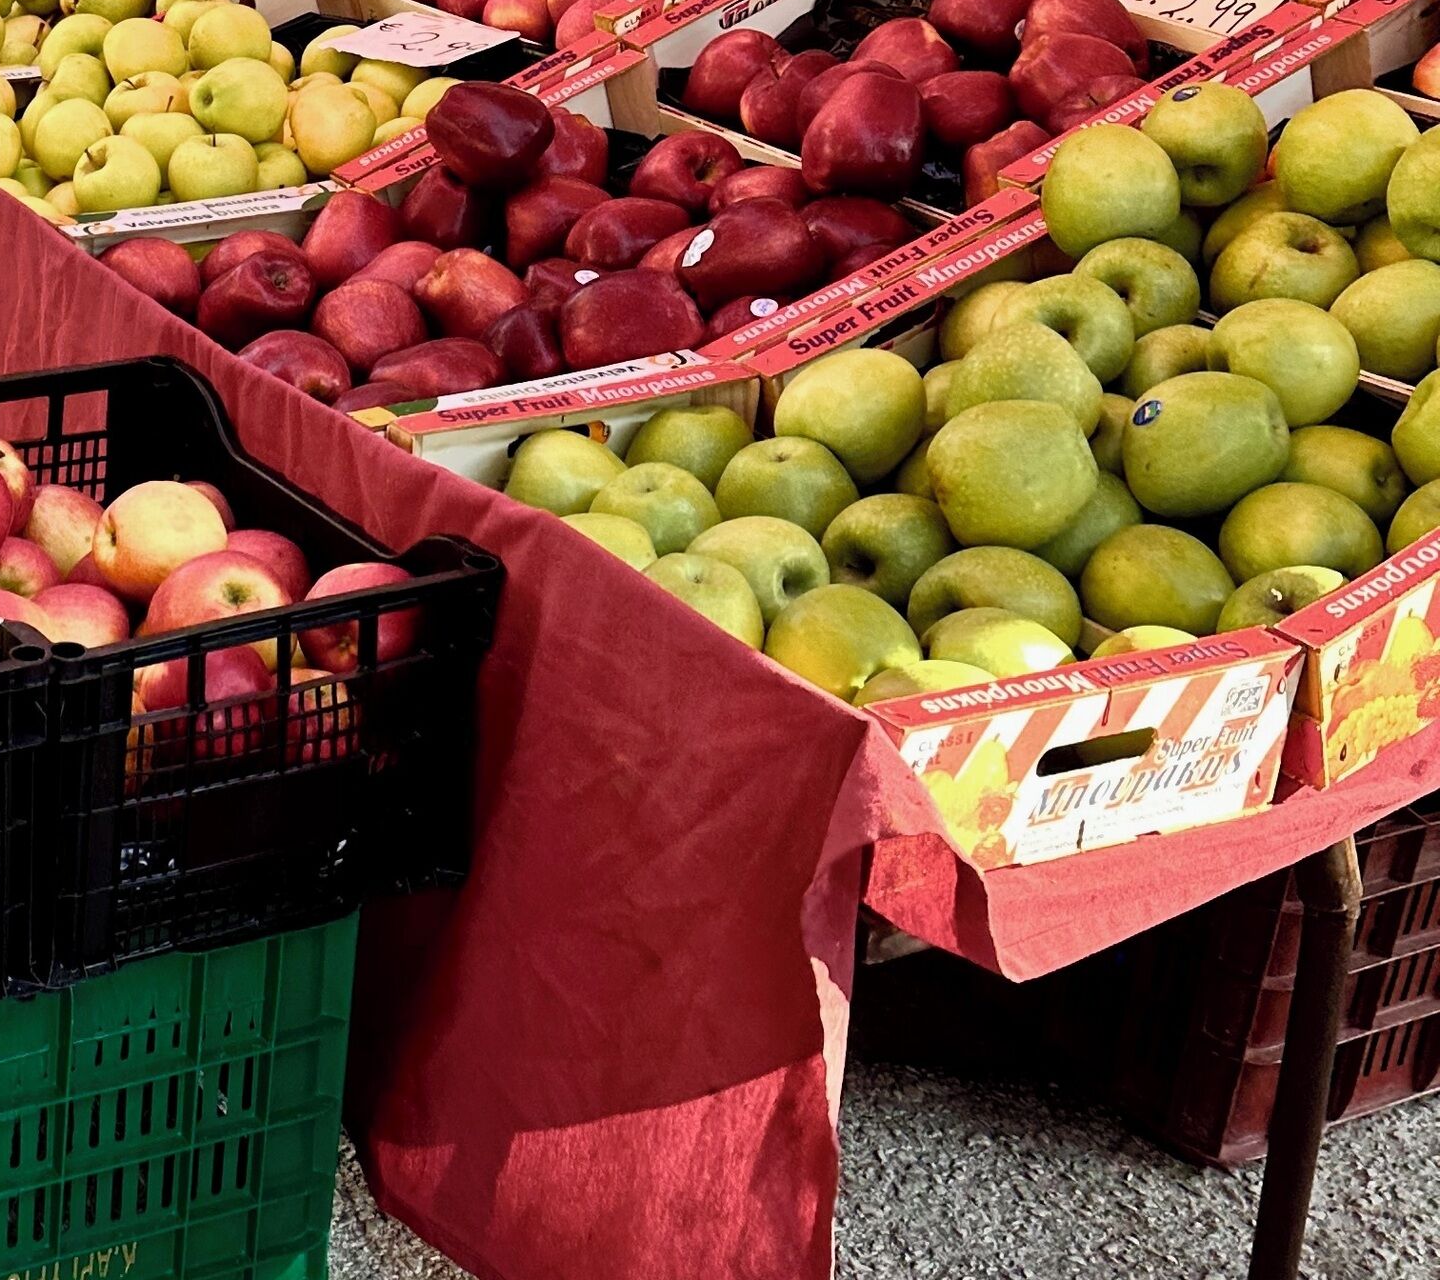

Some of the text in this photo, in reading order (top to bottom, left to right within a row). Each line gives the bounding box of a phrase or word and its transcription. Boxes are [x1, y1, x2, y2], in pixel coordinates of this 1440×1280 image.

[1210, 25, 1275, 64] Super
[521, 50, 577, 82] Super
[394, 152, 442, 176] Supe
[124, 203, 281, 228] Velventos Dimitra
[929, 209, 994, 248] Super
[870, 246, 928, 280] Fruit
[788, 313, 859, 355] Super
[857, 284, 919, 320] Fruit
[542, 365, 645, 391] Velventos
[437, 404, 511, 423] Super
[515, 395, 573, 414] Fruit
[1093, 657, 1157, 686] Fruit
[1160, 640, 1250, 677] Super
[1159, 720, 1259, 765] Super Fruit
